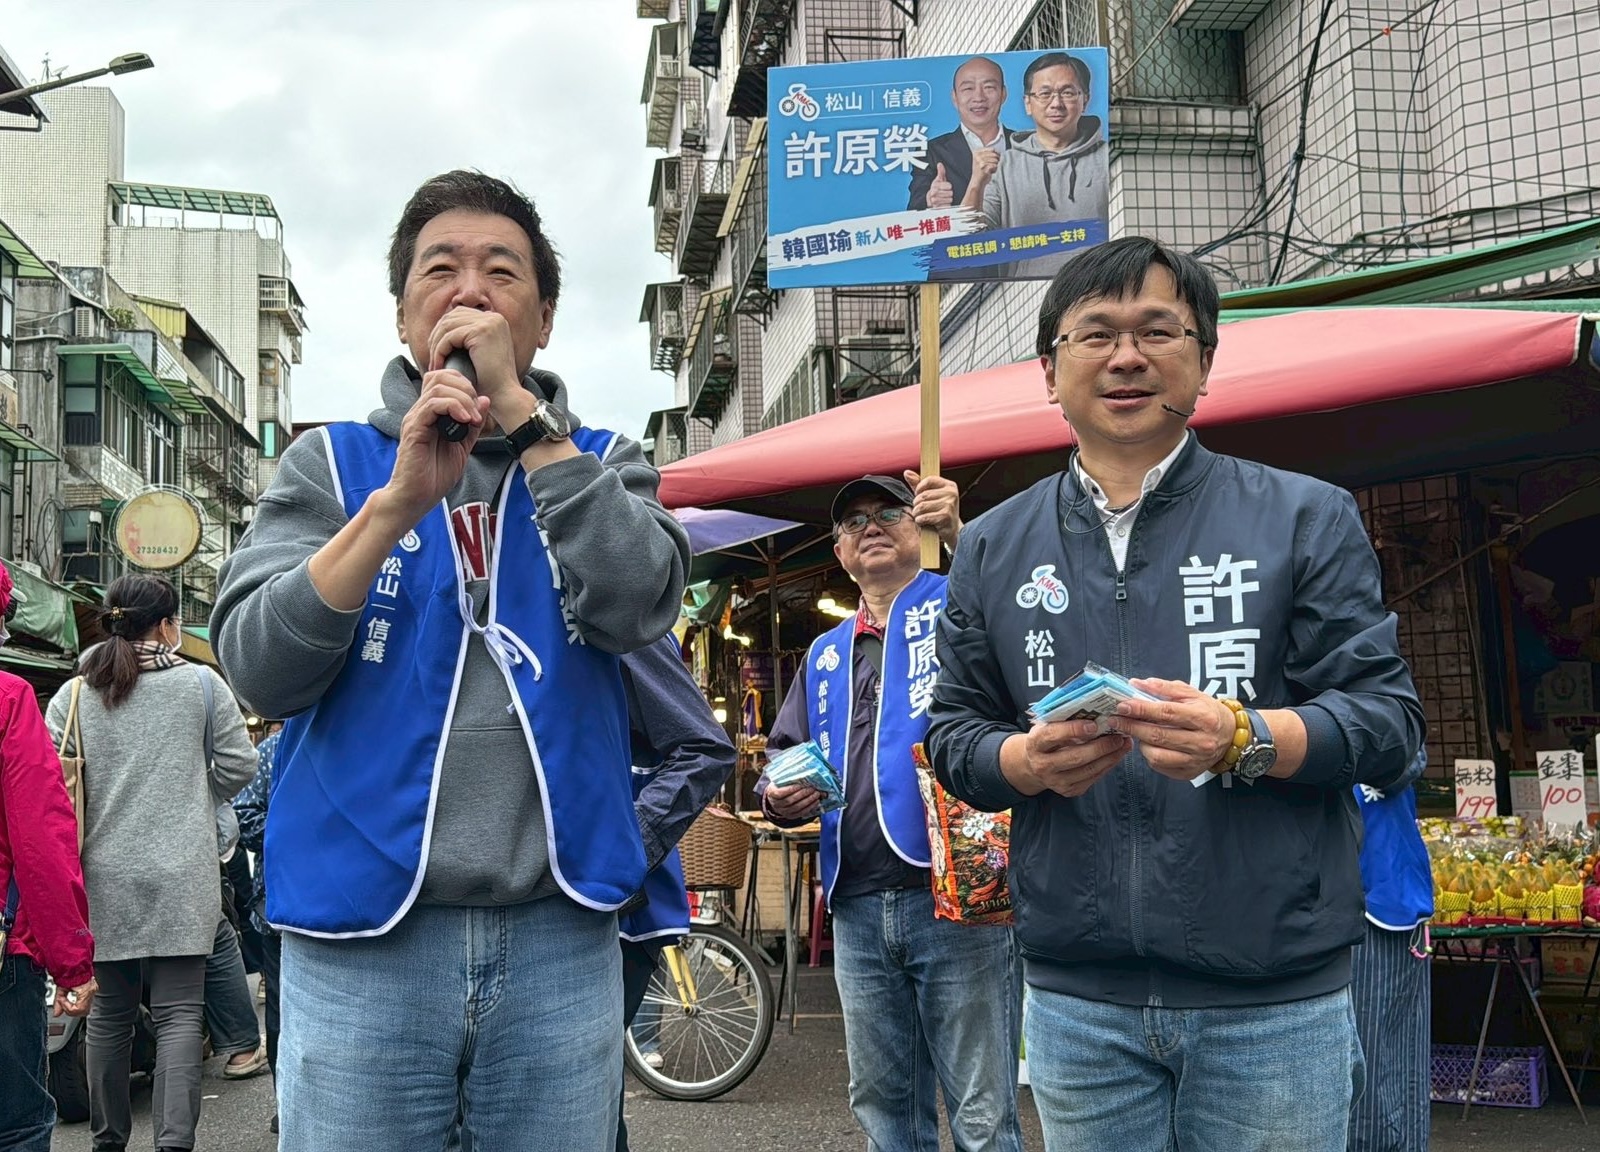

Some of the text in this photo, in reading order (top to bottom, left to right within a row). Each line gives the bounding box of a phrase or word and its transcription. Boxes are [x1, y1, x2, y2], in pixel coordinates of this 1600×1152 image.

[825, 88, 921, 112] 松山 信義
[784, 124, 929, 178] 許原榮
[782, 229, 852, 261] 韓國瑜
[136, 546, 179, 554] 27328432
[361, 556, 402, 663] 松山 信義
[1024, 629, 1055, 688] 松山
[1178, 553, 1260, 788] 許原
[818, 679, 829, 715] 松山
[1457, 796, 1495, 818] 199
[1542, 784, 1582, 811] 100
